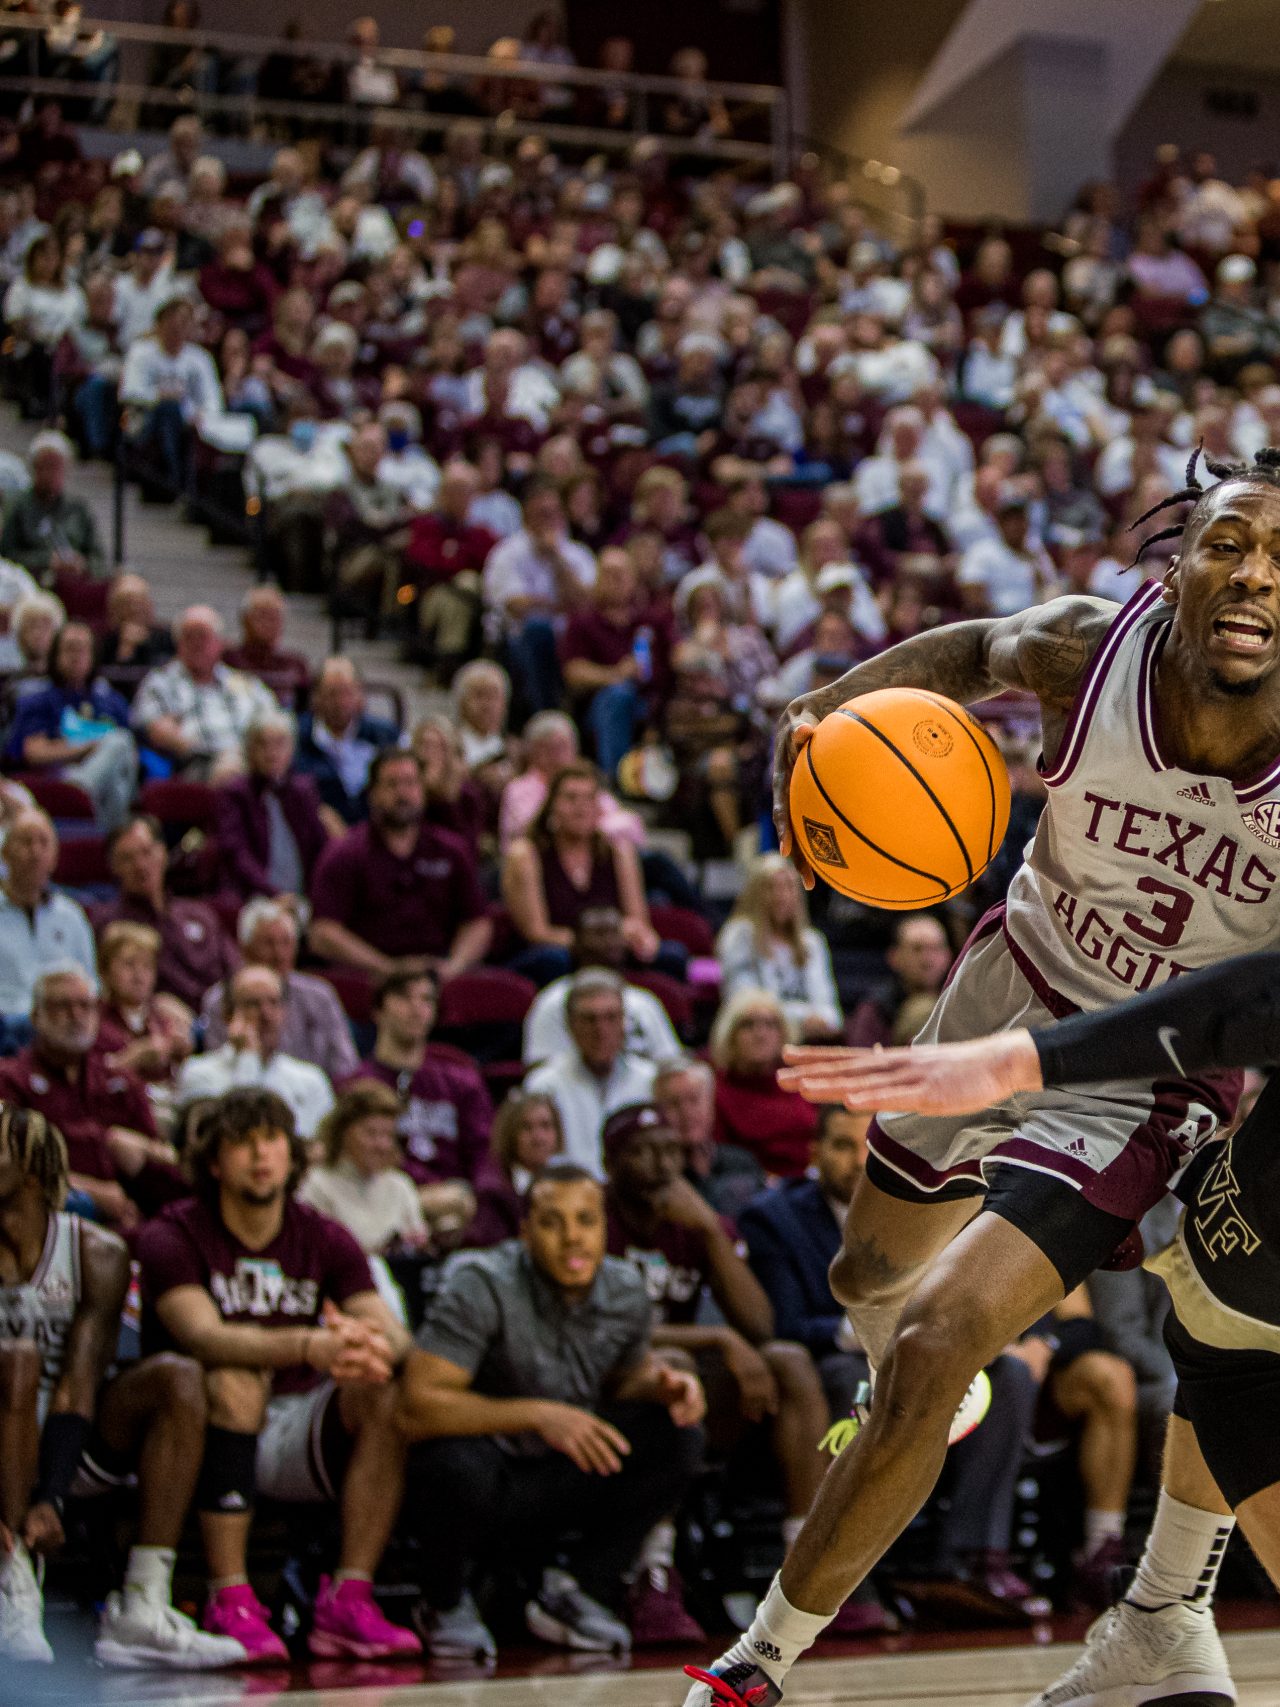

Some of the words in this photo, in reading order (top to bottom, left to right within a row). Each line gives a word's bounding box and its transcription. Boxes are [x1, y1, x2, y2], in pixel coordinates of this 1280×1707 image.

[1176, 789, 1217, 808] adidas
[1084, 791, 1277, 904] TEXAS
[1123, 876, 1195, 947] 3
